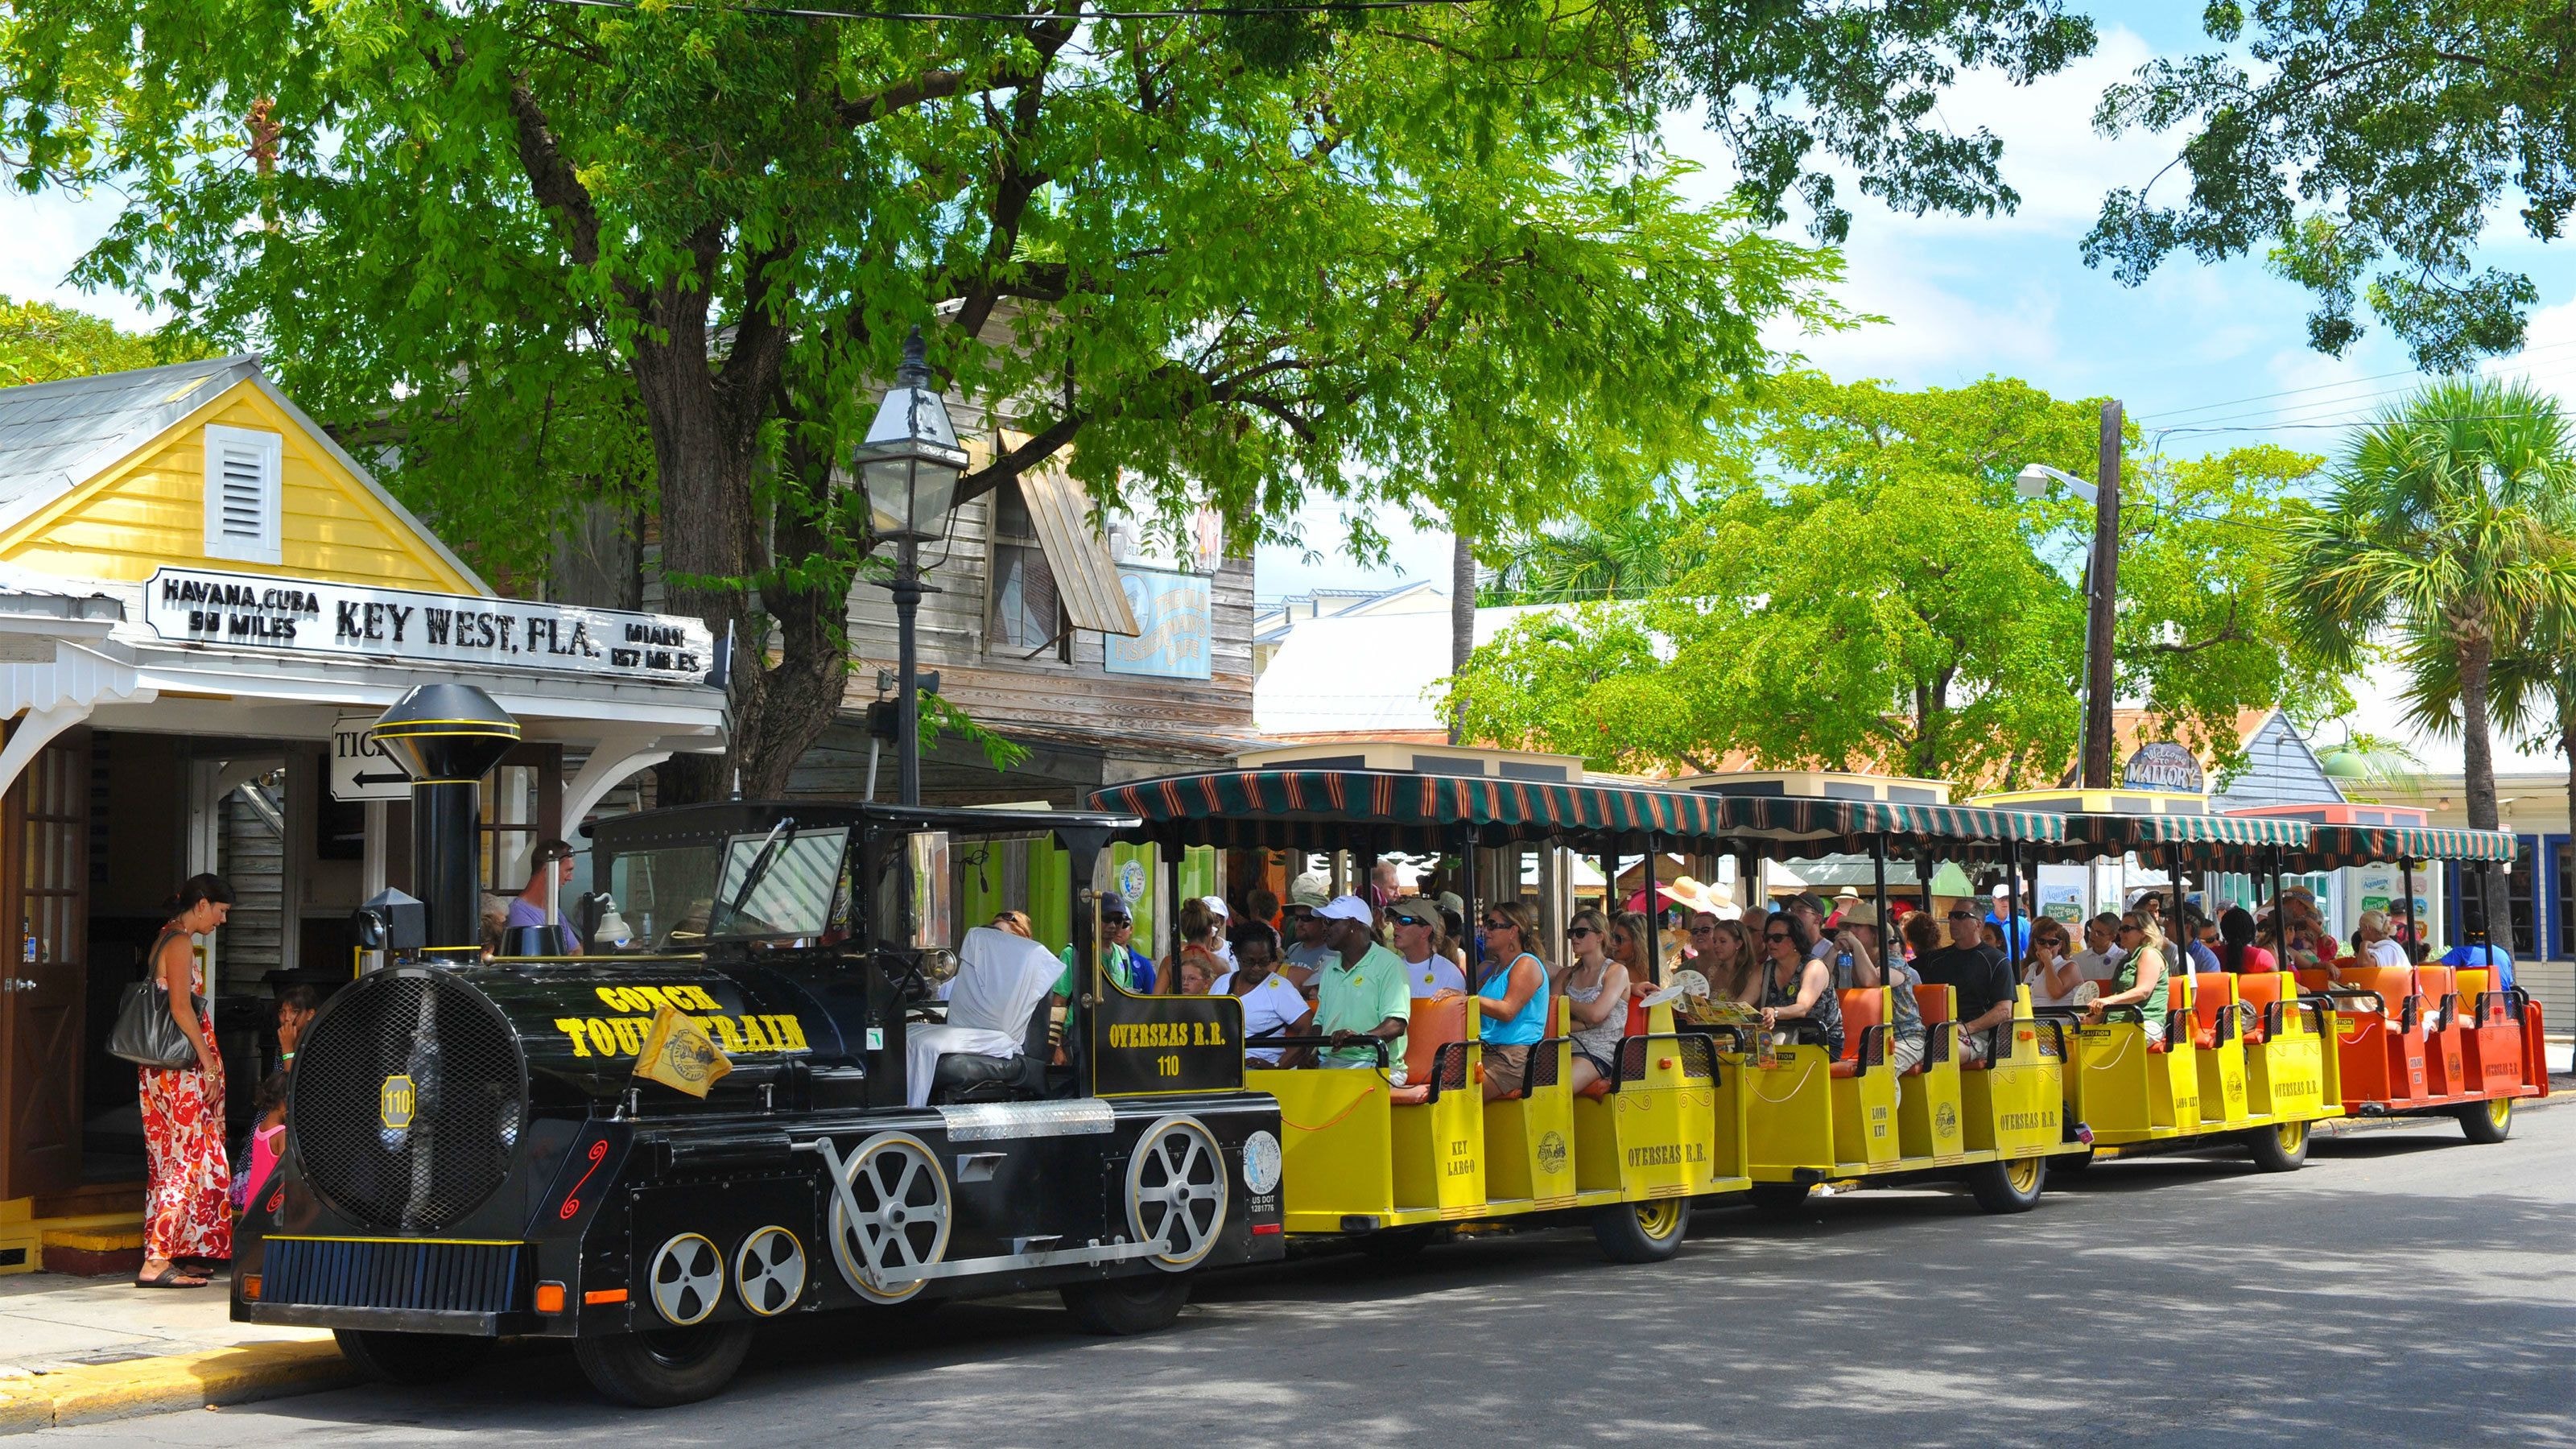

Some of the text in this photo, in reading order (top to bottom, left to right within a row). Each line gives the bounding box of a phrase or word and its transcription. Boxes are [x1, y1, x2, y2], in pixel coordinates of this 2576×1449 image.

[1154, 588, 1207, 620] THE OLD
[229, 613, 297, 638] MILES
[336, 600, 414, 642] KEY
[527, 617, 601, 658] FLA.
[625, 623, 685, 647] MIAMI
[1116, 613, 1206, 661] FISHERMAN'S
[646, 650, 700, 672] MILES
[1166, 638, 1199, 667] CAFE
[2144, 746, 2187, 765] Welcome
[2128, 762, 2198, 789] MALLORY
[596, 986, 723, 1013] CONCH
[1110, 1022, 1225, 1047] OVERSEAS R.R.
[1158, 1055, 1179, 1075] 110
[2274, 1080, 2319, 1098] OVERSEAS R.R.
[386, 1090, 411, 1113] 110
[1872, 1106, 1887, 1120] LONG
[1873, 1124, 1885, 1137] KEY
[2000, 1111, 2057, 1131] OVERSEAS R.R.
[1451, 1140, 1468, 1156] KEY
[1629, 1142, 1707, 1167] OVERSEAS R.R.
[1447, 1159, 1475, 1176] LARGO
[1252, 1195, 1274, 1204] US DOT
